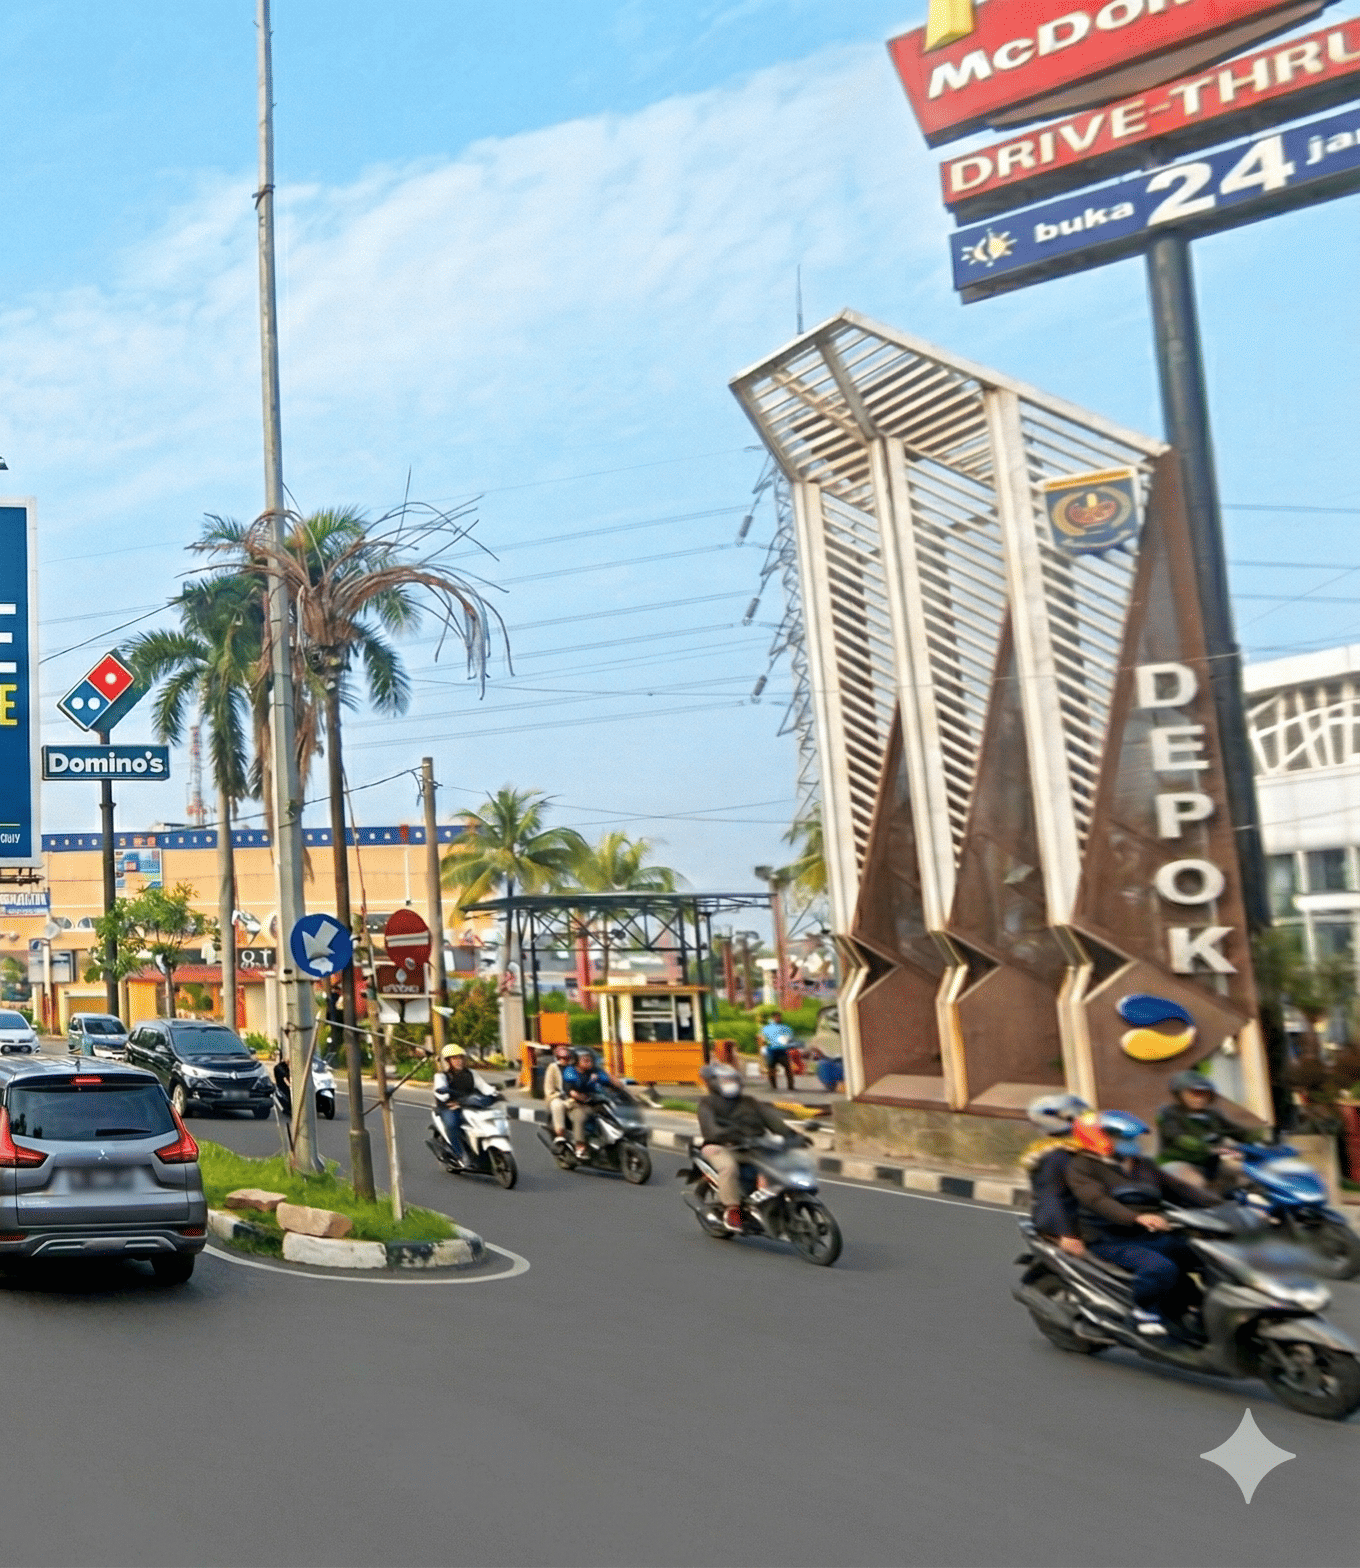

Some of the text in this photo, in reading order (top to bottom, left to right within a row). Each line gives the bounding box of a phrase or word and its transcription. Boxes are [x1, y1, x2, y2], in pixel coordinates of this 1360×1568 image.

[1035, 128, 1360, 243] buka 24 ja
[48, 751, 164, 774] Domino's
[1134, 662, 1238, 975] DEPOK
